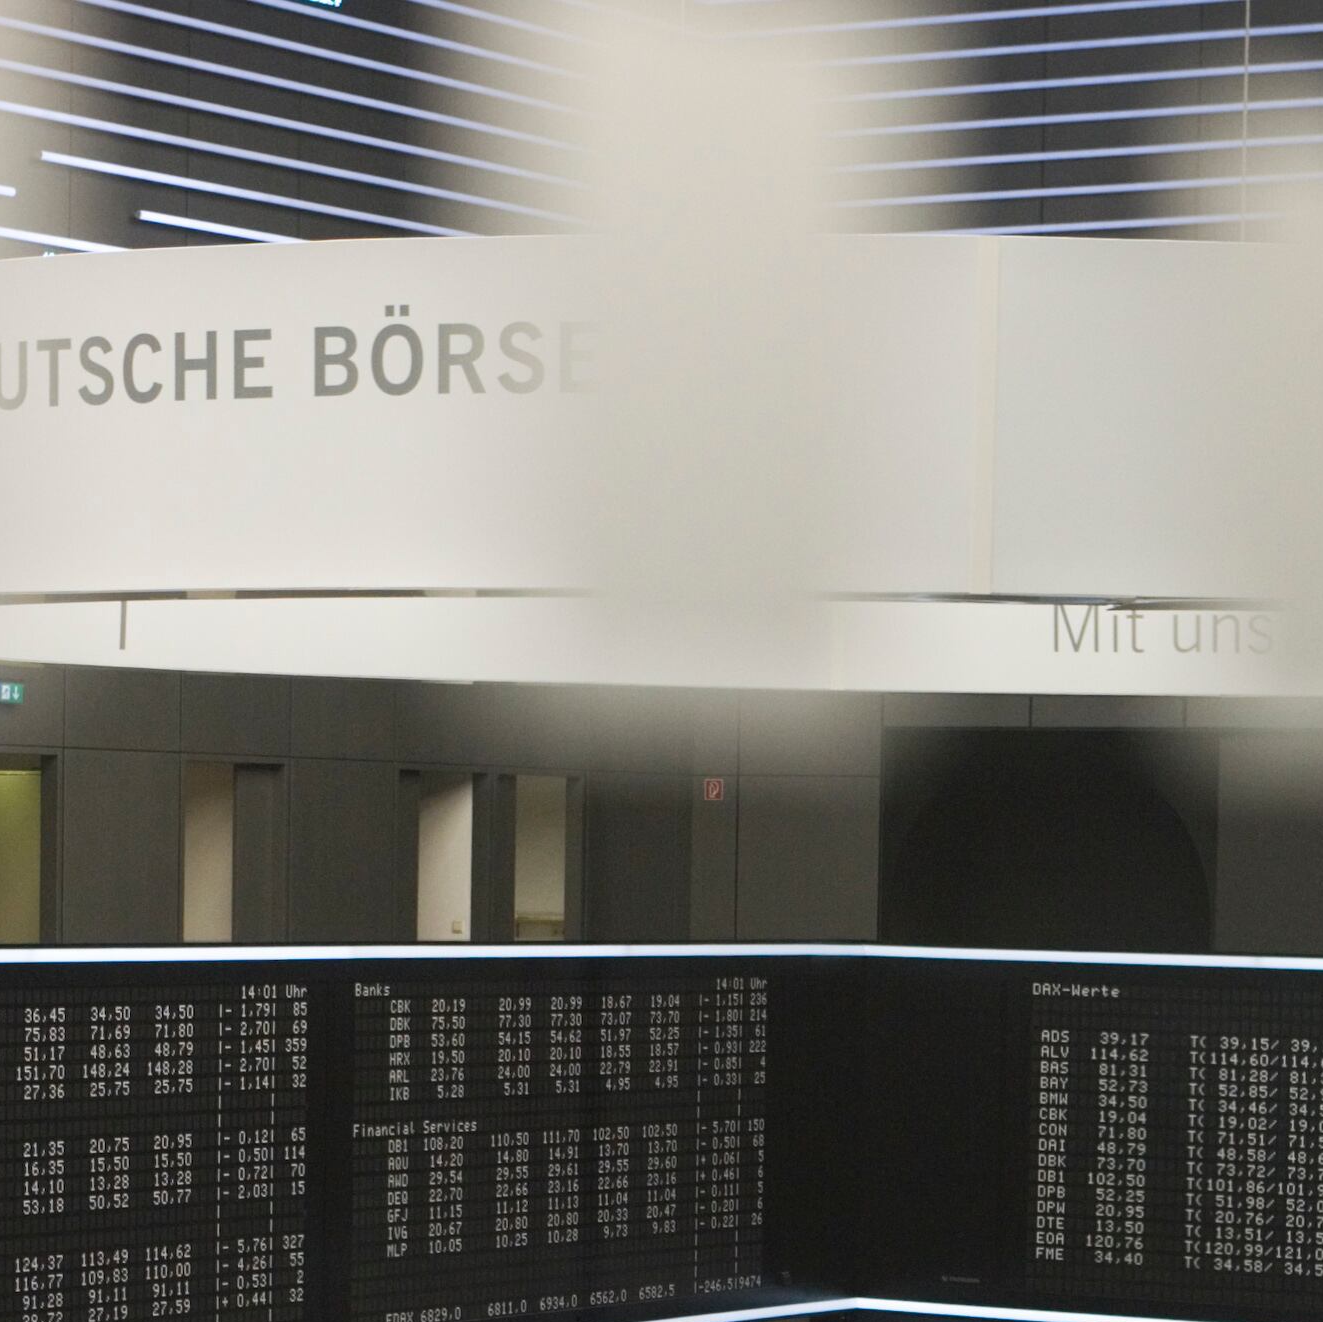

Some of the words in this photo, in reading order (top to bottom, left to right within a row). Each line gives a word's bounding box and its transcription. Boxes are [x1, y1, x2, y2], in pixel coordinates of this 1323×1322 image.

[313, 304, 603, 397] BÖRSE
[1052, 604, 1144, 653] Mit
[1173, 614, 1272, 654] uns
[242, 985, 276, 999] 14:01
[286, 985, 307, 998] Uhr
[355, 984, 390, 996] Banks
[717, 978, 743, 990] 14:01
[750, 978, 767, 989] Uhr
[1033, 984, 1119, 996] DAX-Werte
[391, 1000, 410, 1013] CBK
[390, 1017, 410, 1030] DBK
[390, 1035, 410, 1048] DPB
[1042, 1030, 1069, 1042] ADS
[390, 1052, 410, 1065] HRX
[1041, 1046, 1069, 1058] ALV
[1041, 1061, 1068, 1073] BAS
[390, 1070, 408, 1082] ARL
[1040, 1077, 1068, 1088] BAY
[391, 1087, 409, 1100] IKB
[1040, 1092, 1067, 1104] BMW
[1040, 1108, 1067, 1120] CBK
[353, 1124, 414, 1136] Financial
[424, 1121, 476, 1133] Services
[1039, 1123, 1067, 1135] CON
[389, 1139, 407, 1153] DB1
[1039, 1139, 1065, 1151] DAI
[388, 1157, 408, 1170] AQU
[1038, 1154, 1065, 1166] DBK
[388, 1174, 408, 1187] AWD
[1038, 1170, 1063, 1182] DB1
[1038, 1185, 1065, 1198] DPB
[1037, 1201, 1065, 1213] DPW
[388, 1209, 407, 1222] GFJ
[1037, 1216, 1064, 1229] DTE
[387, 1243, 407, 1257] MLP
[1036, 1247, 1063, 1260] FME
[421, 1307, 461, 1322] 6829,0
